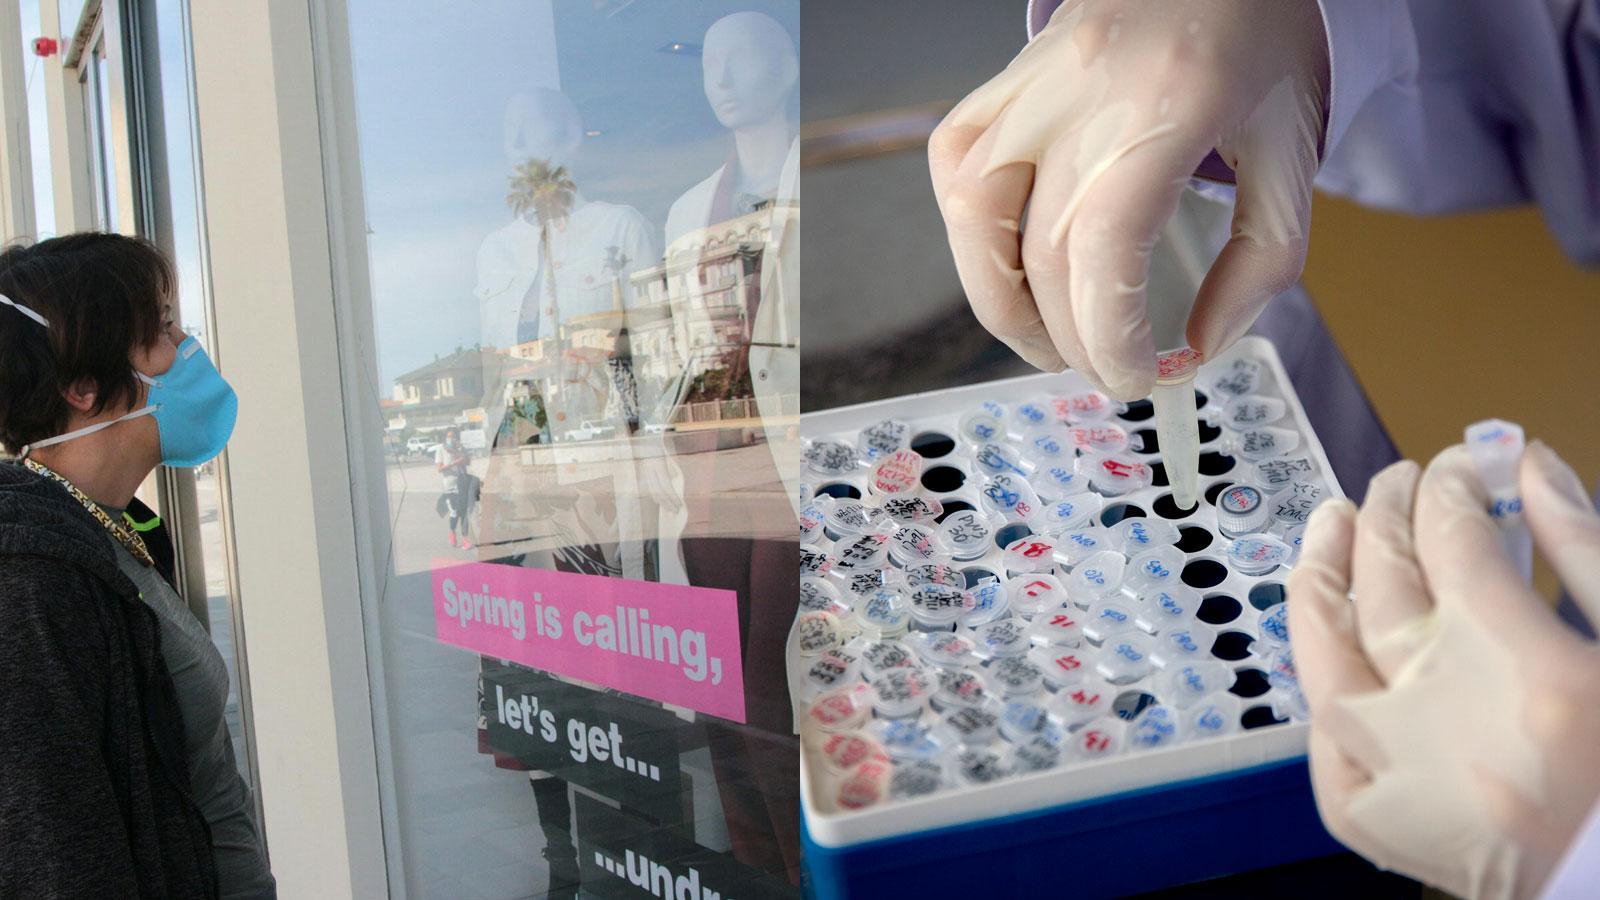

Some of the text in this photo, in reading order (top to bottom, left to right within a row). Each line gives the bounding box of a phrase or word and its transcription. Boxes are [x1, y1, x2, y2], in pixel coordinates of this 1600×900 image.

[442, 579, 722, 686] Spring is calling,
[496, 685, 660, 781] let's get...
